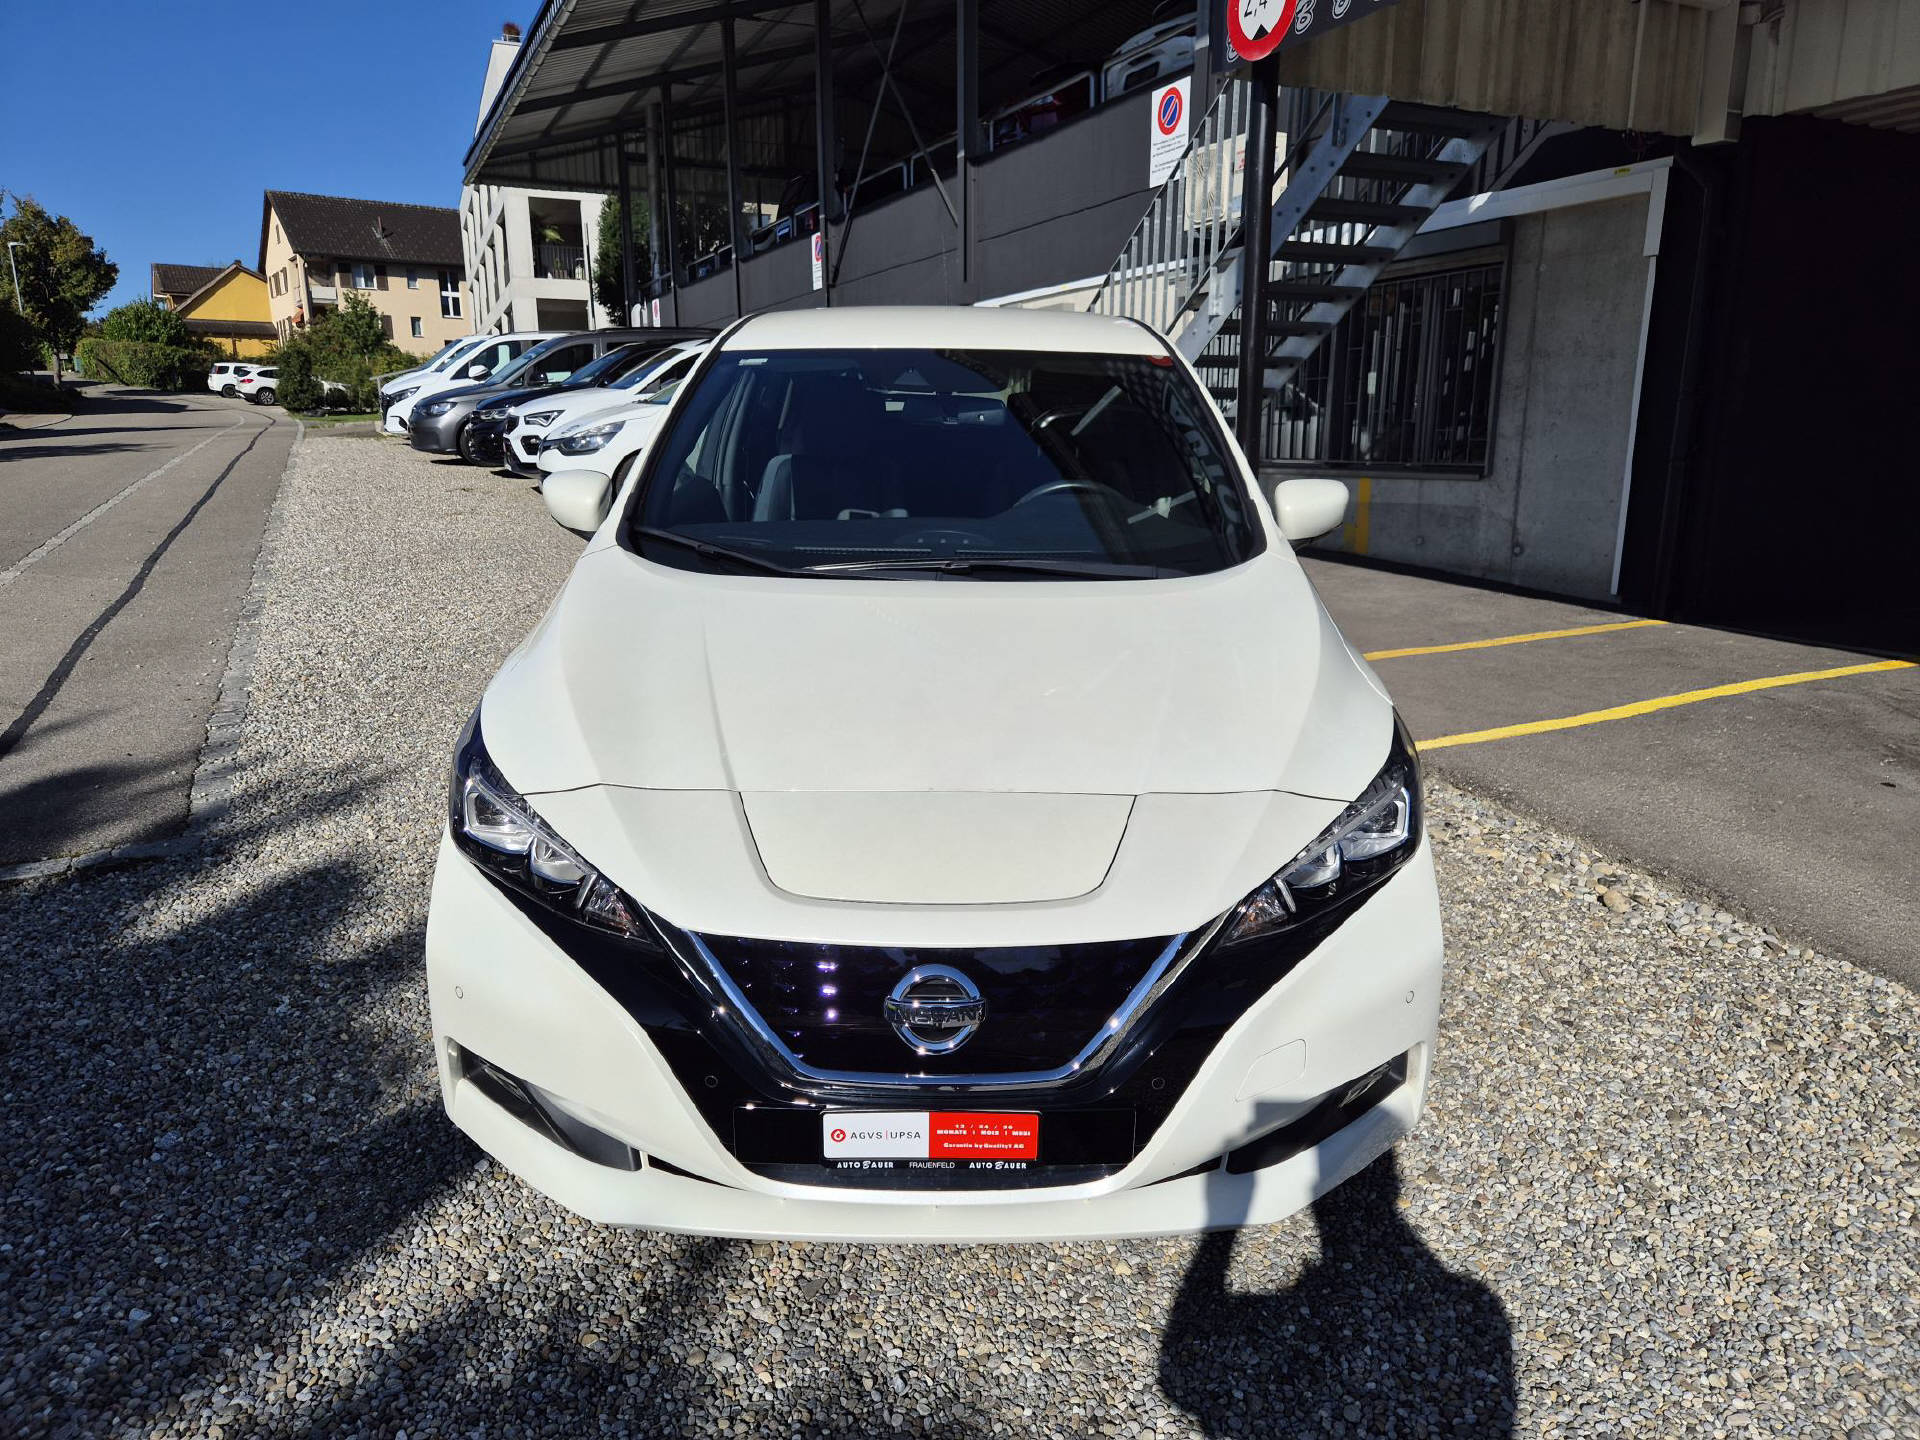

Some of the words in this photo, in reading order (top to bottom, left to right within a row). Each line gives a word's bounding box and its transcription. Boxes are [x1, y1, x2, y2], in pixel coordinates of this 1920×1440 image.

[850, 1131, 883, 1139] AGVS
[890, 1131, 921, 1139] UPSA
[836, 1161, 861, 1169] AUTO
[909, 1161, 956, 1169] FRAUENFELD
